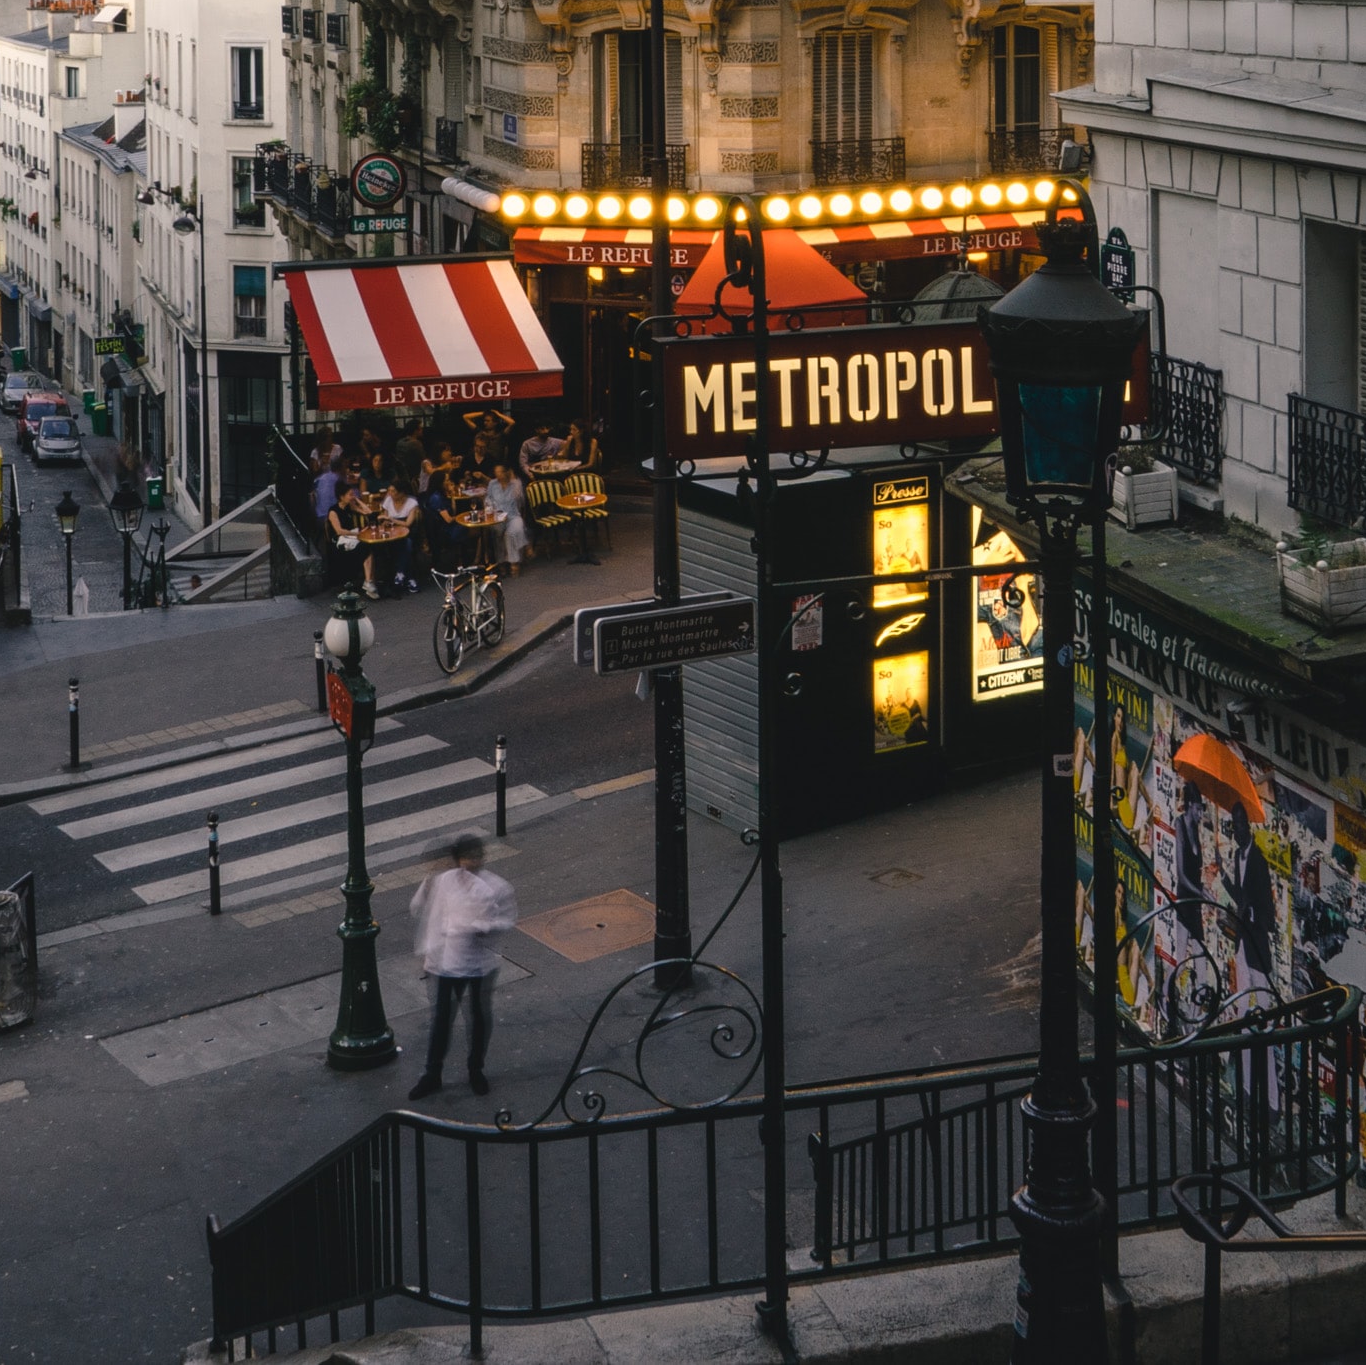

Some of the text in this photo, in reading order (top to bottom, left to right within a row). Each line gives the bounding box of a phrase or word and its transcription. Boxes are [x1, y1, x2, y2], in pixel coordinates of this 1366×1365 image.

[353, 217, 407, 232] Le REFUGE
[923, 231, 1023, 254] LE REFUGE
[566, 246, 689, 265] LE REFUE
[1111, 253, 1123, 264] RUE
[1106, 261, 1128, 276] PIERRE
[1111, 272, 1124, 284] DAC
[373, 380, 511, 405] LE REFUGE
[683, 346, 994, 435] METROPOL
[877, 482, 926, 502] Presse
[621, 615, 714, 637] Butte Montmartre
[621, 628, 720, 651] Musée Montmartre
[1162, 635, 1177, 662] et
[621, 639, 734, 665] Par la rue des Saules
